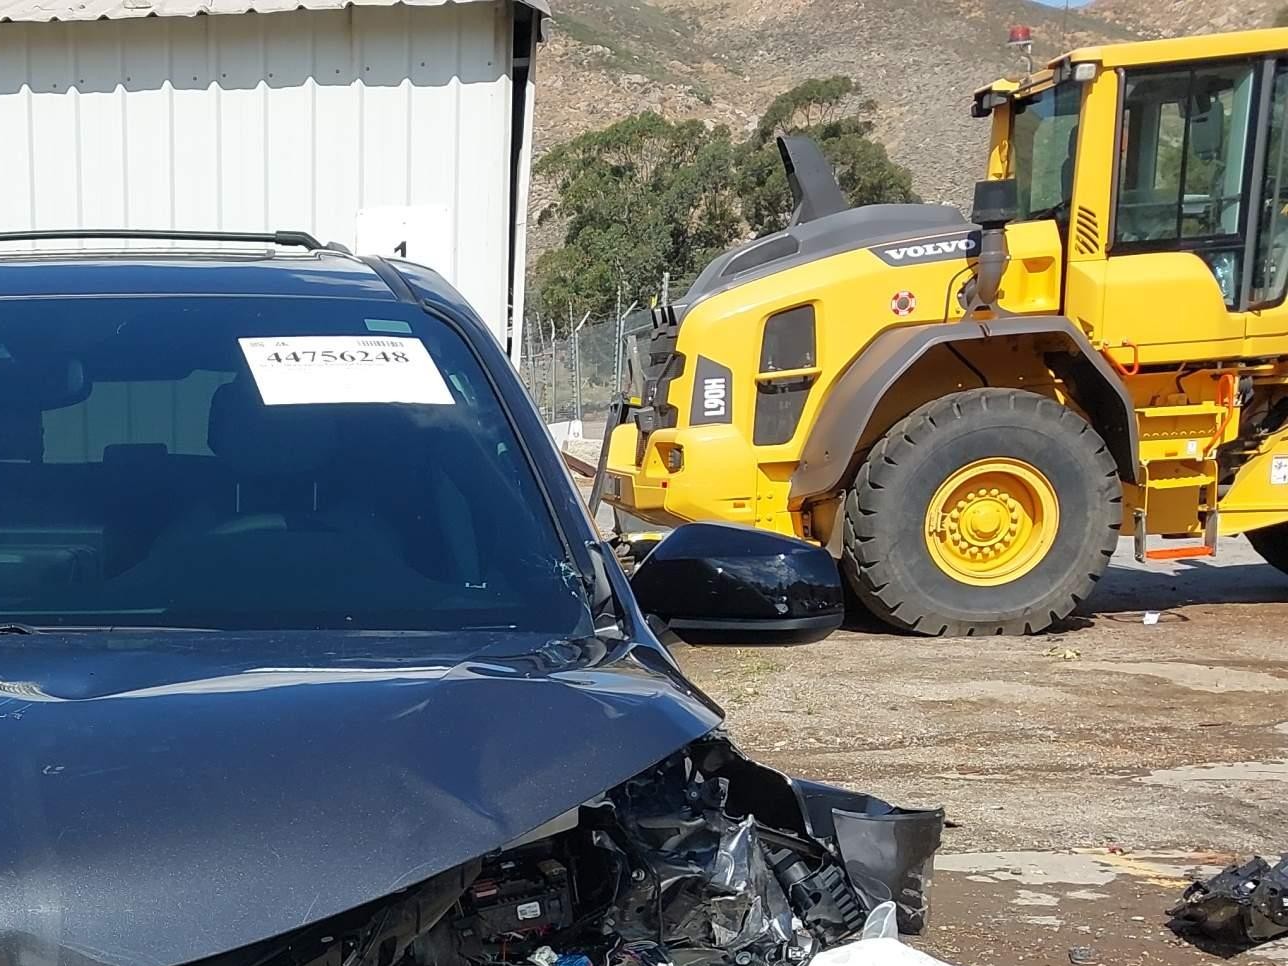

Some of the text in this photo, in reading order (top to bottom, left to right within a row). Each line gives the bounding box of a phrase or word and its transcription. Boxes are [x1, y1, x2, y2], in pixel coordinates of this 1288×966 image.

[393, 240, 407, 258] 1
[884, 238, 976, 260] VOLVO
[266, 350, 410, 363] 44756248
[703, 377, 726, 416] L90H
